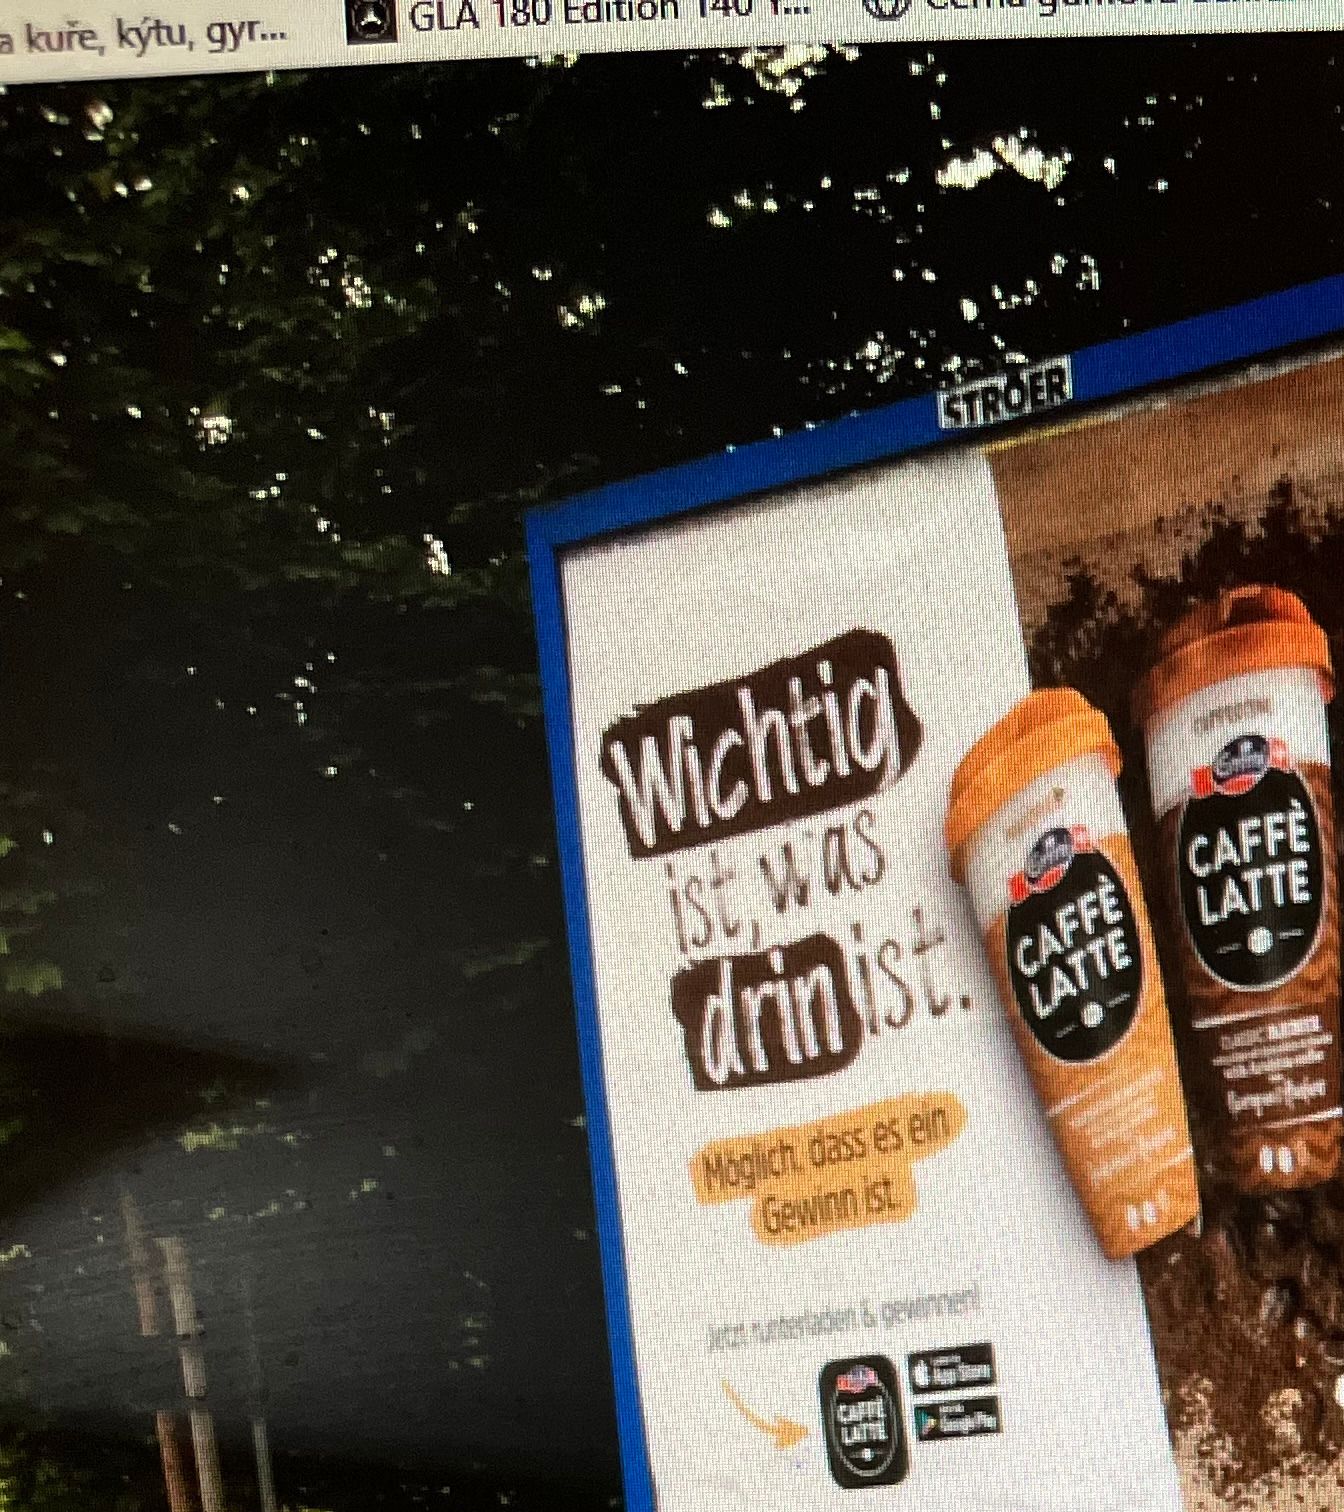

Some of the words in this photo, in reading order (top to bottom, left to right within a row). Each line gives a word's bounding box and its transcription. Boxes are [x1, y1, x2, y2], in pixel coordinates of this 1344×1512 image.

[26, 20, 104, 56] kuře,
[117, 16, 193, 57] kýtu,
[207, 20, 287, 53] gyr...
[410, 1, 479, 31] GLA
[493, 0, 551, 27] 180
[609, 660, 901, 850] Wichtig
[1185, 799, 1311, 878] CAFFÈ
[664, 850, 762, 956] ist,
[760, 809, 887, 914] was
[1196, 860, 1312, 926] LATTE
[1014, 873, 1125, 979] CAFFÈ
[695, 948, 845, 1087] drin
[850, 908, 970, 1037] ist.
[1029, 928, 1134, 1020] LATTE
[808, 1129, 867, 1168] dass
[875, 1118, 904, 1152] es
[909, 1107, 947, 1145] ein
[762, 1187, 859, 1235] Gewinn
